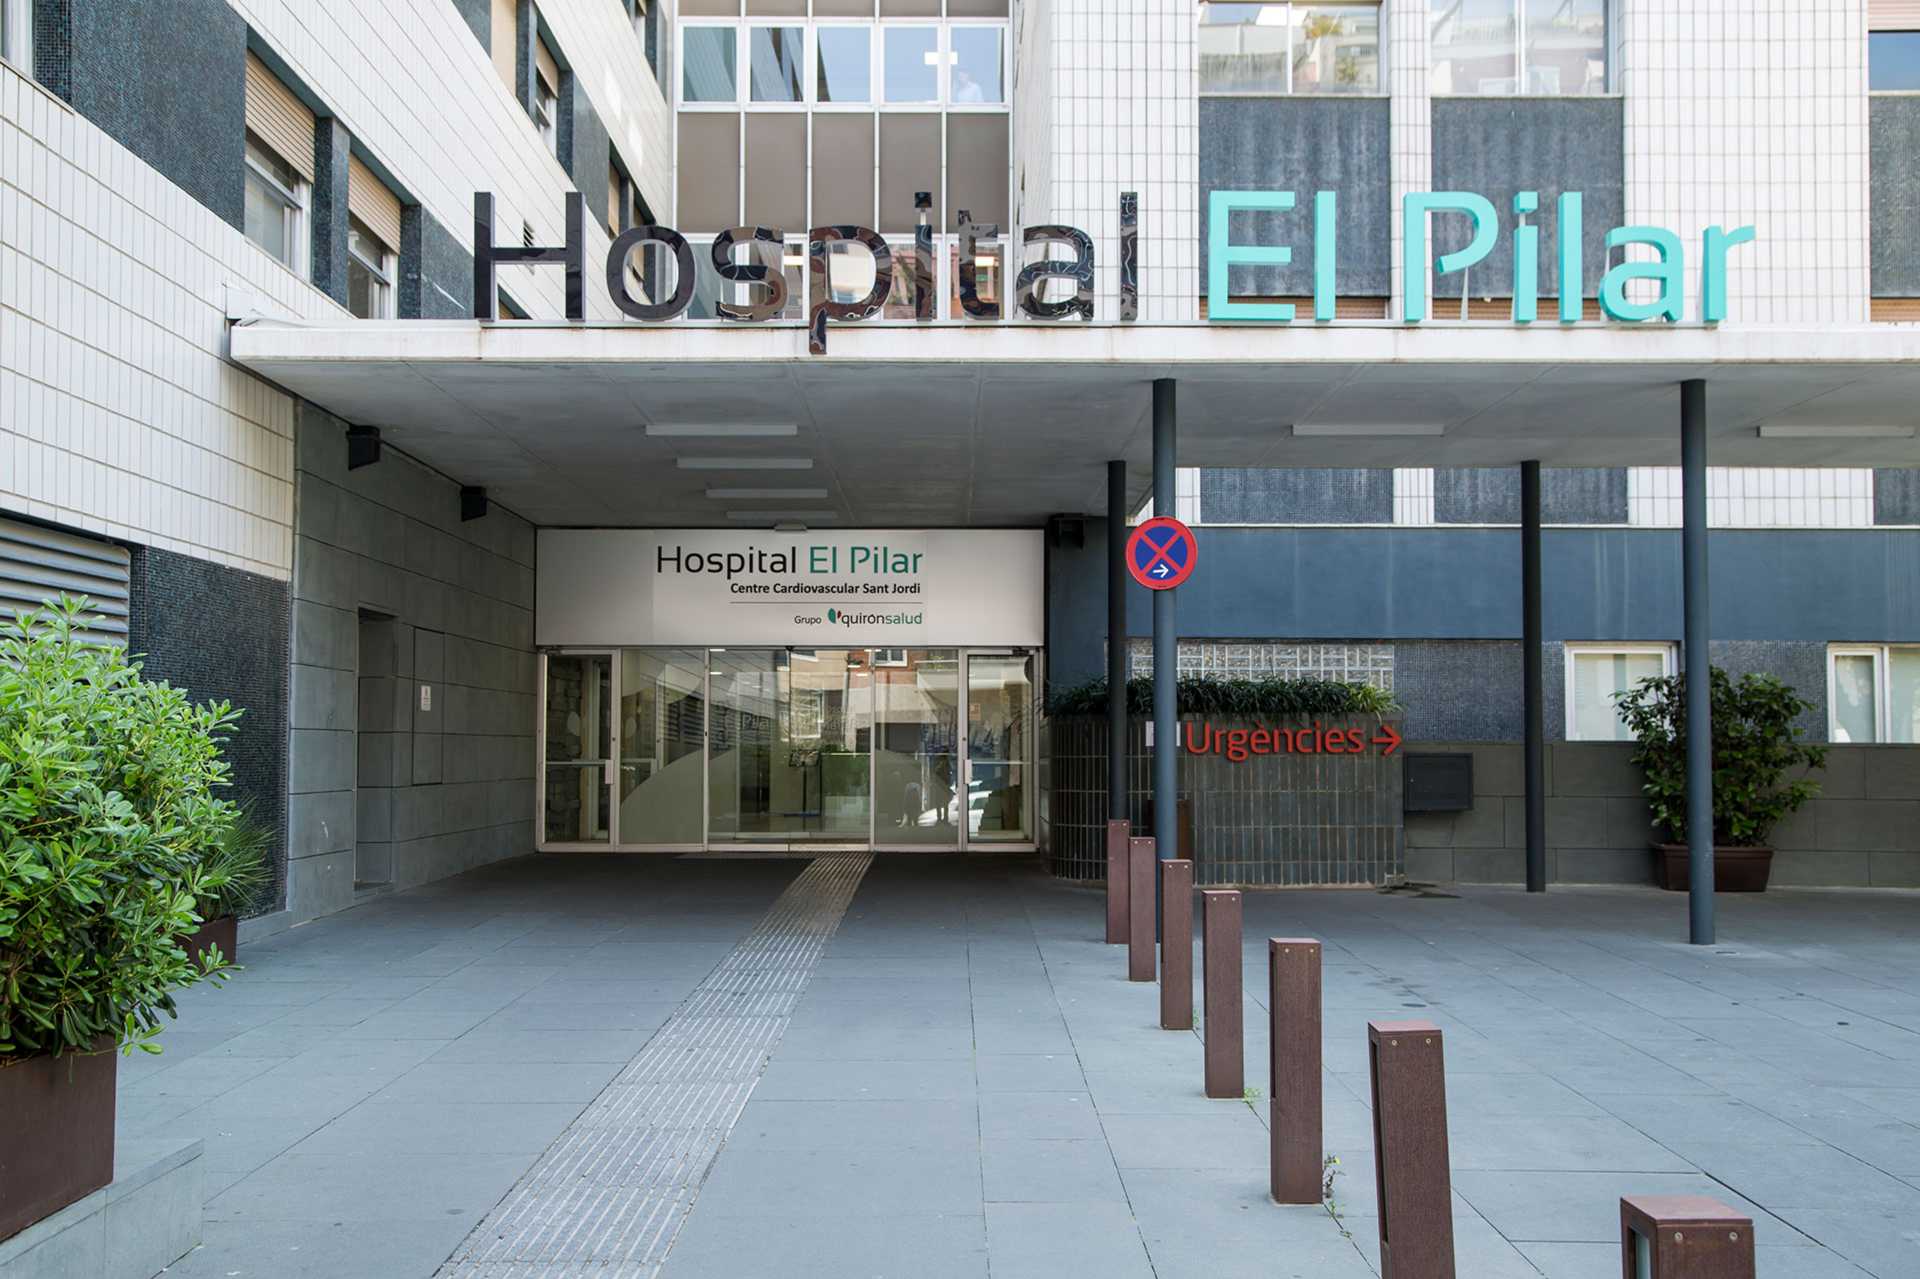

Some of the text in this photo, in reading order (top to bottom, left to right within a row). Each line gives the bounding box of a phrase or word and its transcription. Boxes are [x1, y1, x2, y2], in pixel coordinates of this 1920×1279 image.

[474, 190, 1756, 355] Hospital El Pilar
[656, 546, 923, 580] Hospital El Pilar
[730, 582, 921, 594] Centre Cardiovascular Sant Jordi
[794, 615, 822, 625] Grupo
[1185, 720, 1366, 762] Urgències
